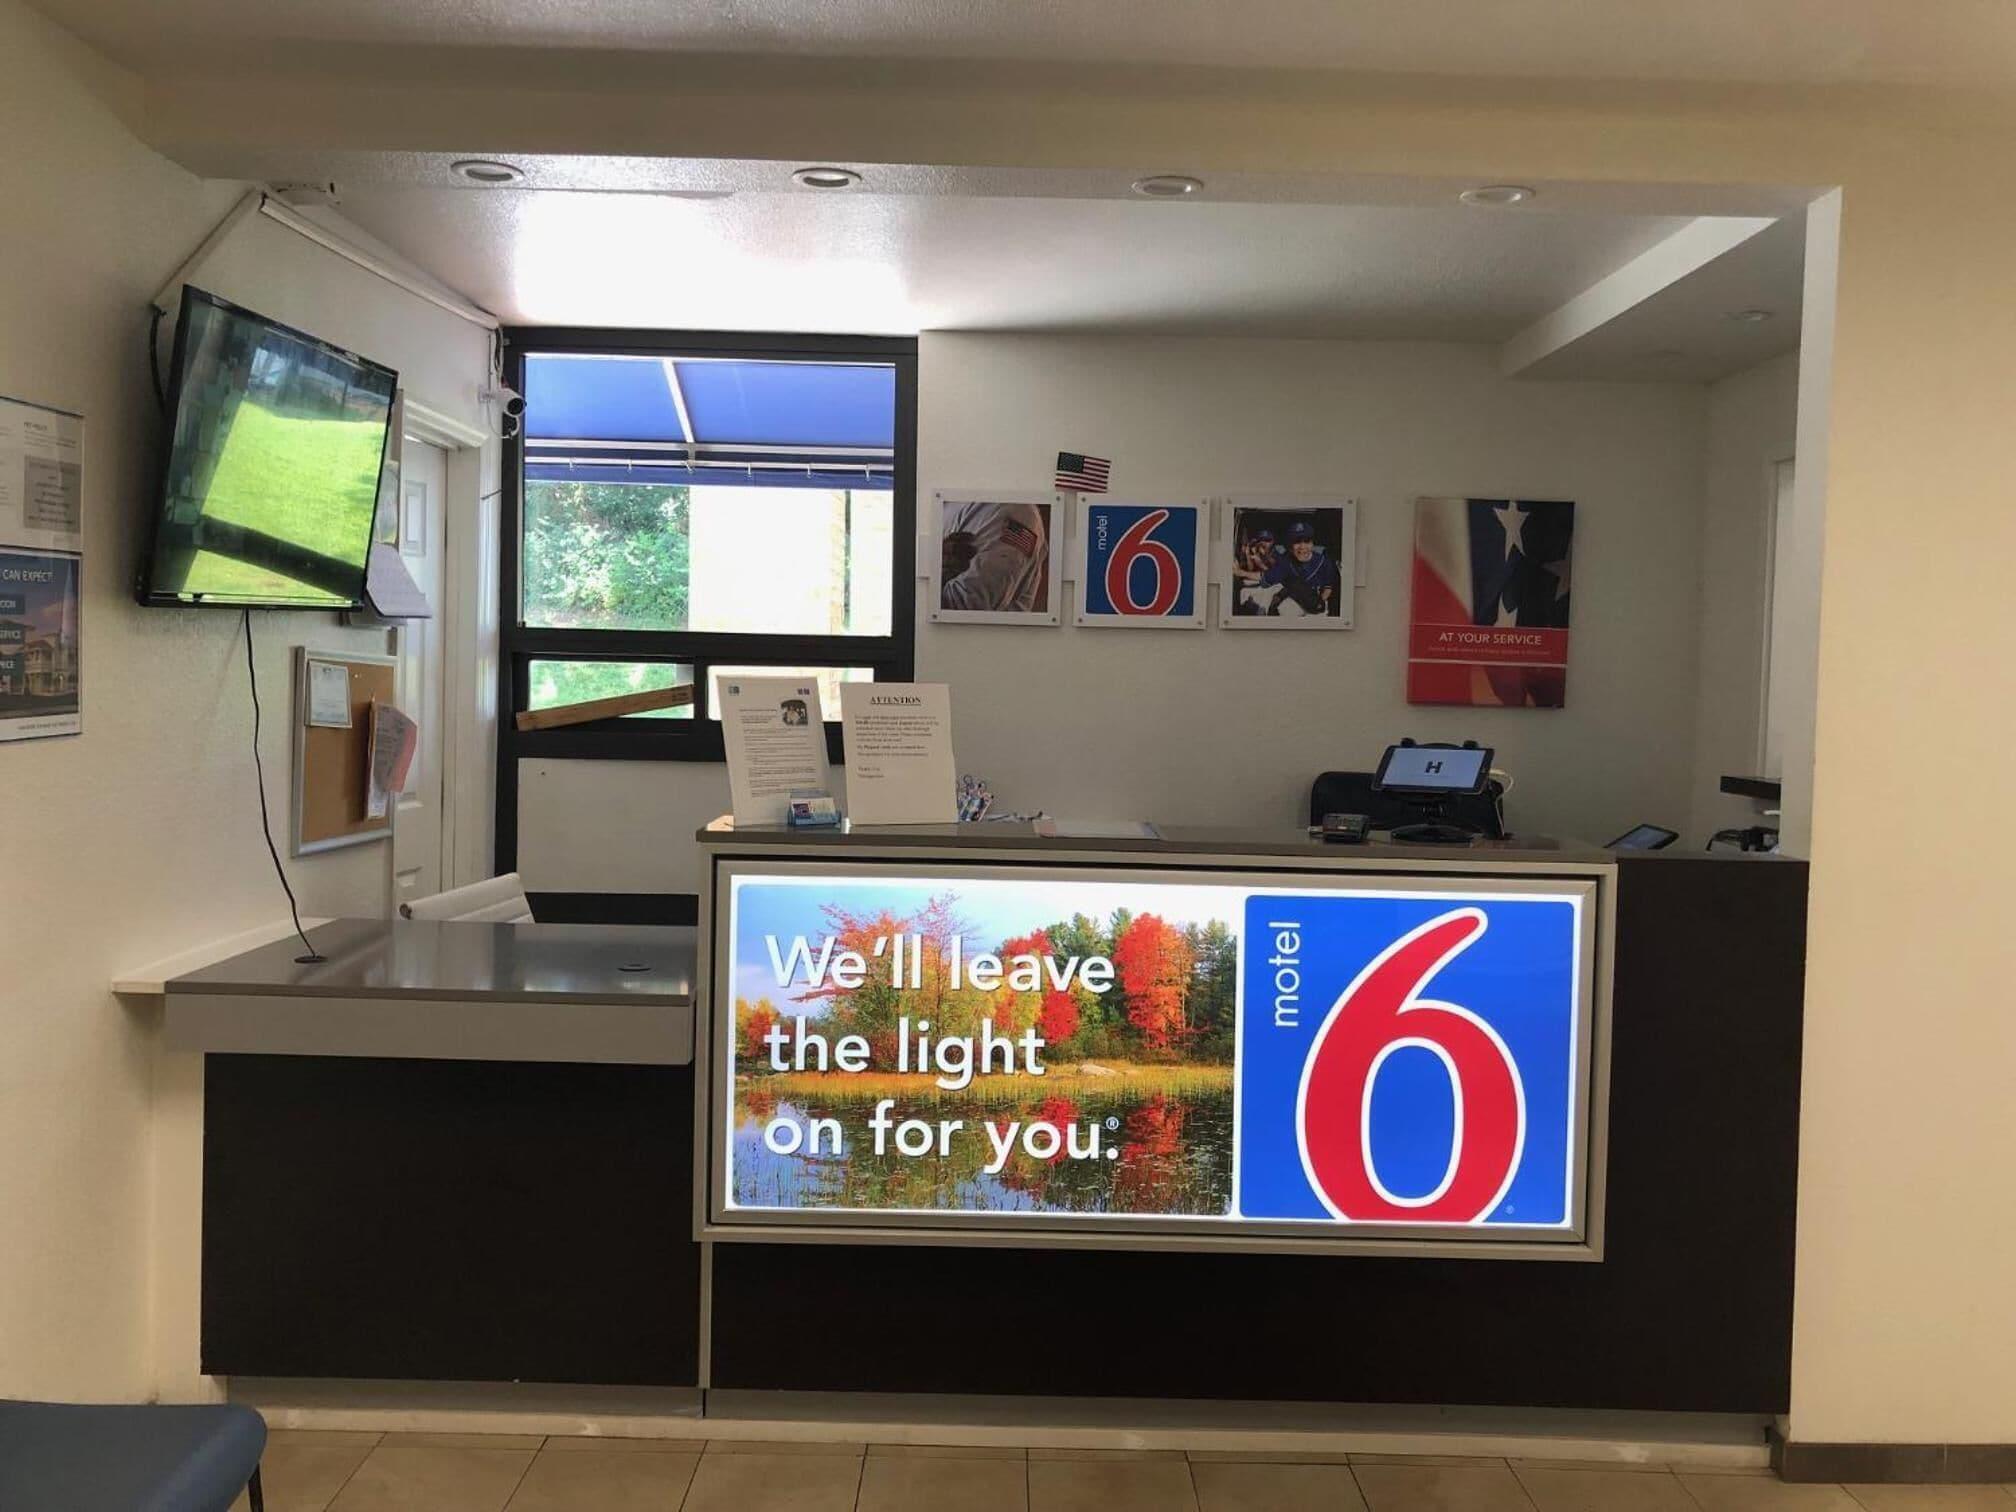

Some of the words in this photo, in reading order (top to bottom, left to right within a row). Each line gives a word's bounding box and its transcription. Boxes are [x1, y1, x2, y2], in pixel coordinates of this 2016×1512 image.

[2, 569, 20, 581] CAN
[1096, 515, 1108, 550] motel
[1105, 509, 1181, 616] 6
[1439, 632, 1454, 642] AT
[1457, 632, 1490, 644] YOUR
[1493, 634, 1542, 645] SERVICE
[870, 696, 921, 705] ATTENTION
[764, 934, 923, 990] We'll
[950, 934, 1116, 993] leave
[764, 1016, 871, 1073] the
[897, 1016, 1046, 1091] light
[1268, 921, 1300, 1027] motel
[1295, 907, 1527, 1223] 6
[764, 1117, 844, 1156] on
[868, 1099, 964, 1157] for
